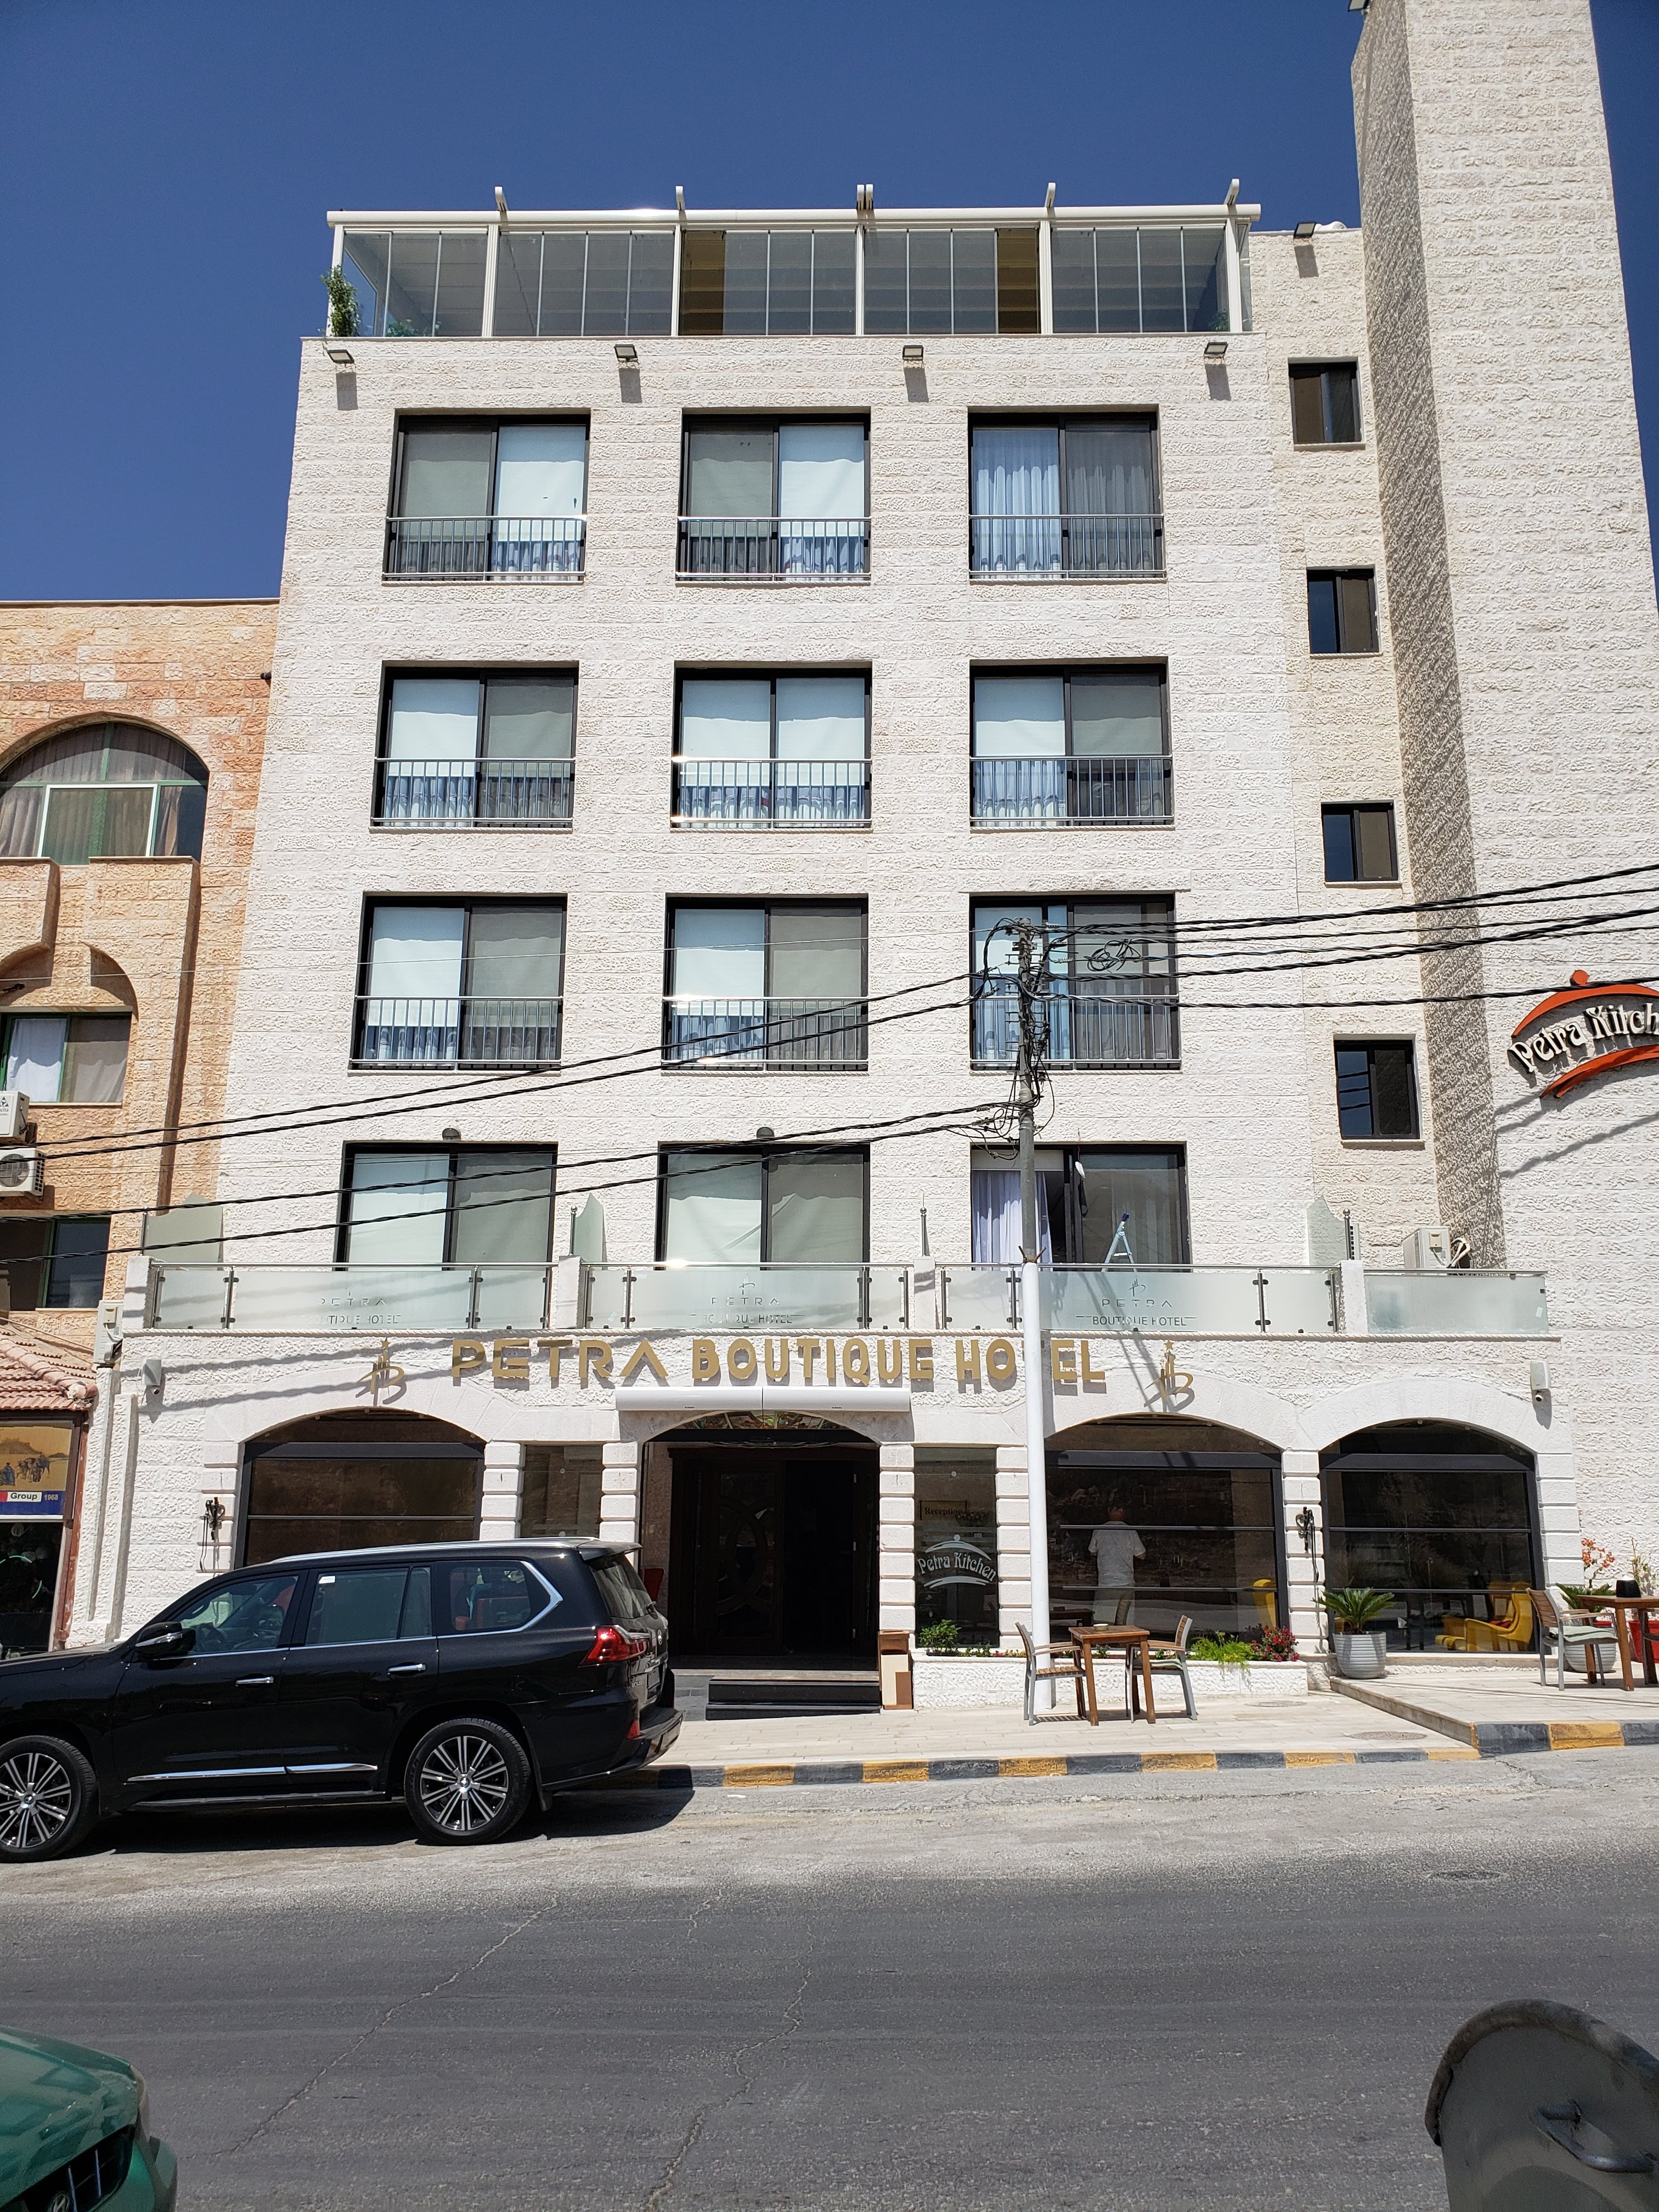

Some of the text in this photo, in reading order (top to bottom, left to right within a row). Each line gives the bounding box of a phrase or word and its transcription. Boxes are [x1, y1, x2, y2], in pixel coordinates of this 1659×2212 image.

[1509, 1022, 1588, 1073] Petra
[711, 1297, 780, 1305] PETRA
[1102, 1299, 1172, 1307] PETRA
[759, 1314, 793, 1324] HOTEL
[1092, 1316, 1187, 1326] BOUTIQUE HOTEL
[451, 1338, 1105, 1386] PETRA BOUTIQUE HOEL
[10, 1492, 37, 1501] Group
[917, 1551, 996, 1582] Petra Kitchen
